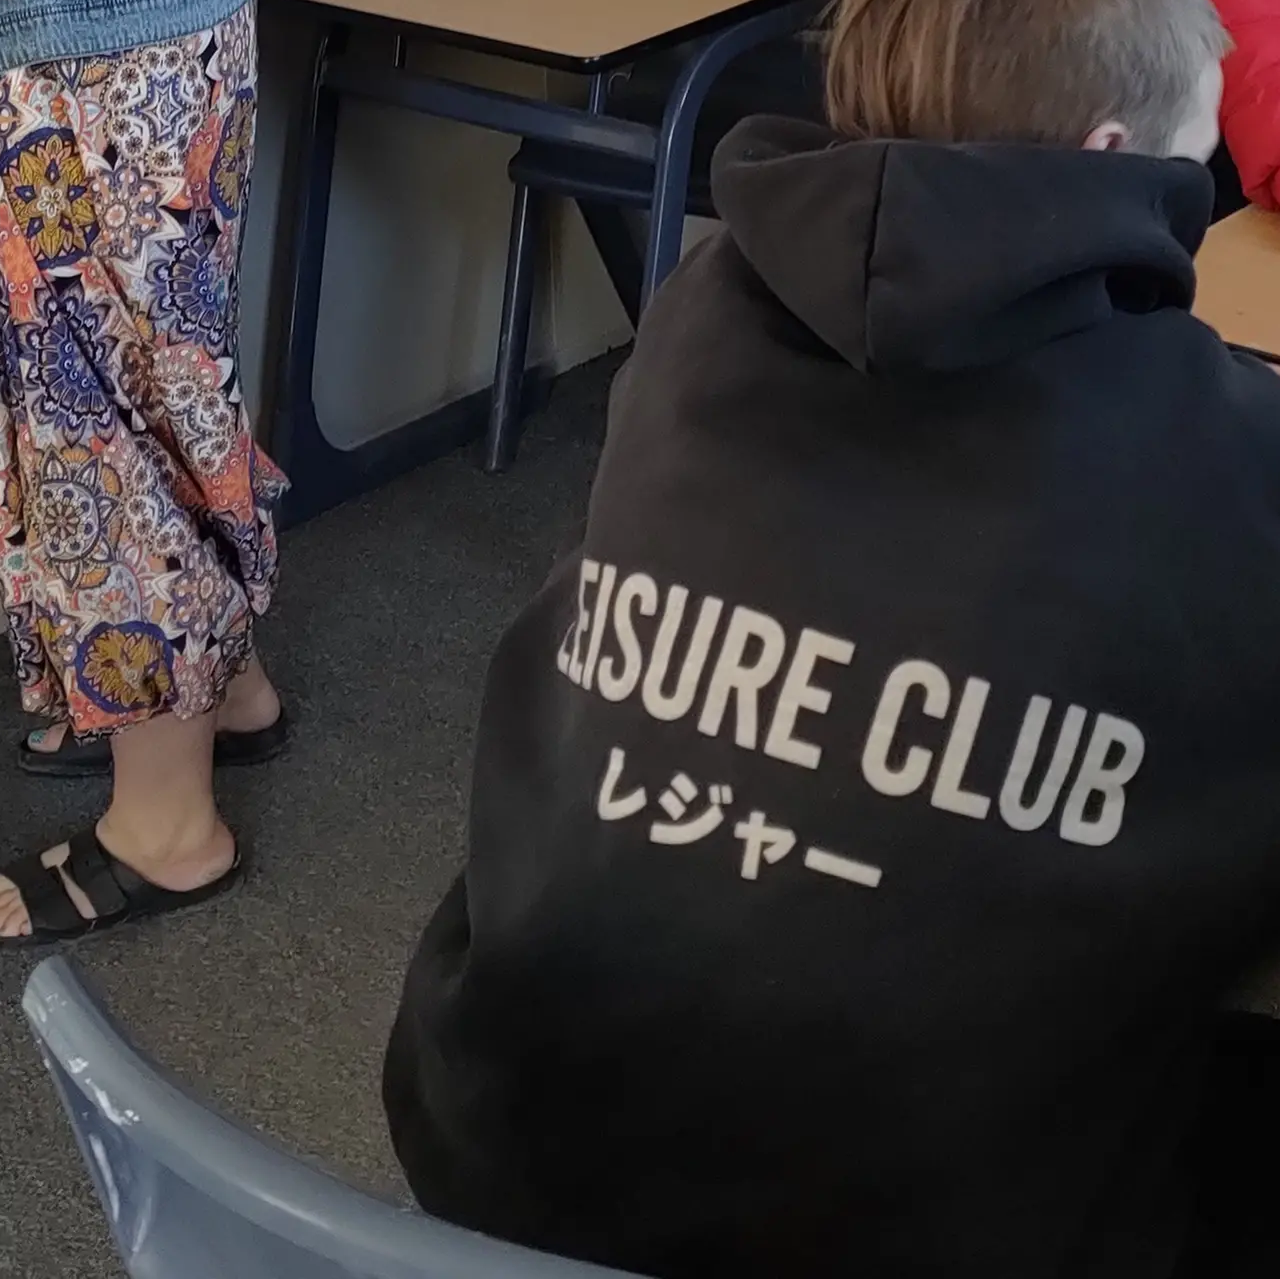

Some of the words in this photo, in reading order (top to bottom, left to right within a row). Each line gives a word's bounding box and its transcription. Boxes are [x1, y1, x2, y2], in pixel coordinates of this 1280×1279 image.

[597, 746, 883, 889] レジャー
[860, 659, 1146, 848] CLUB
